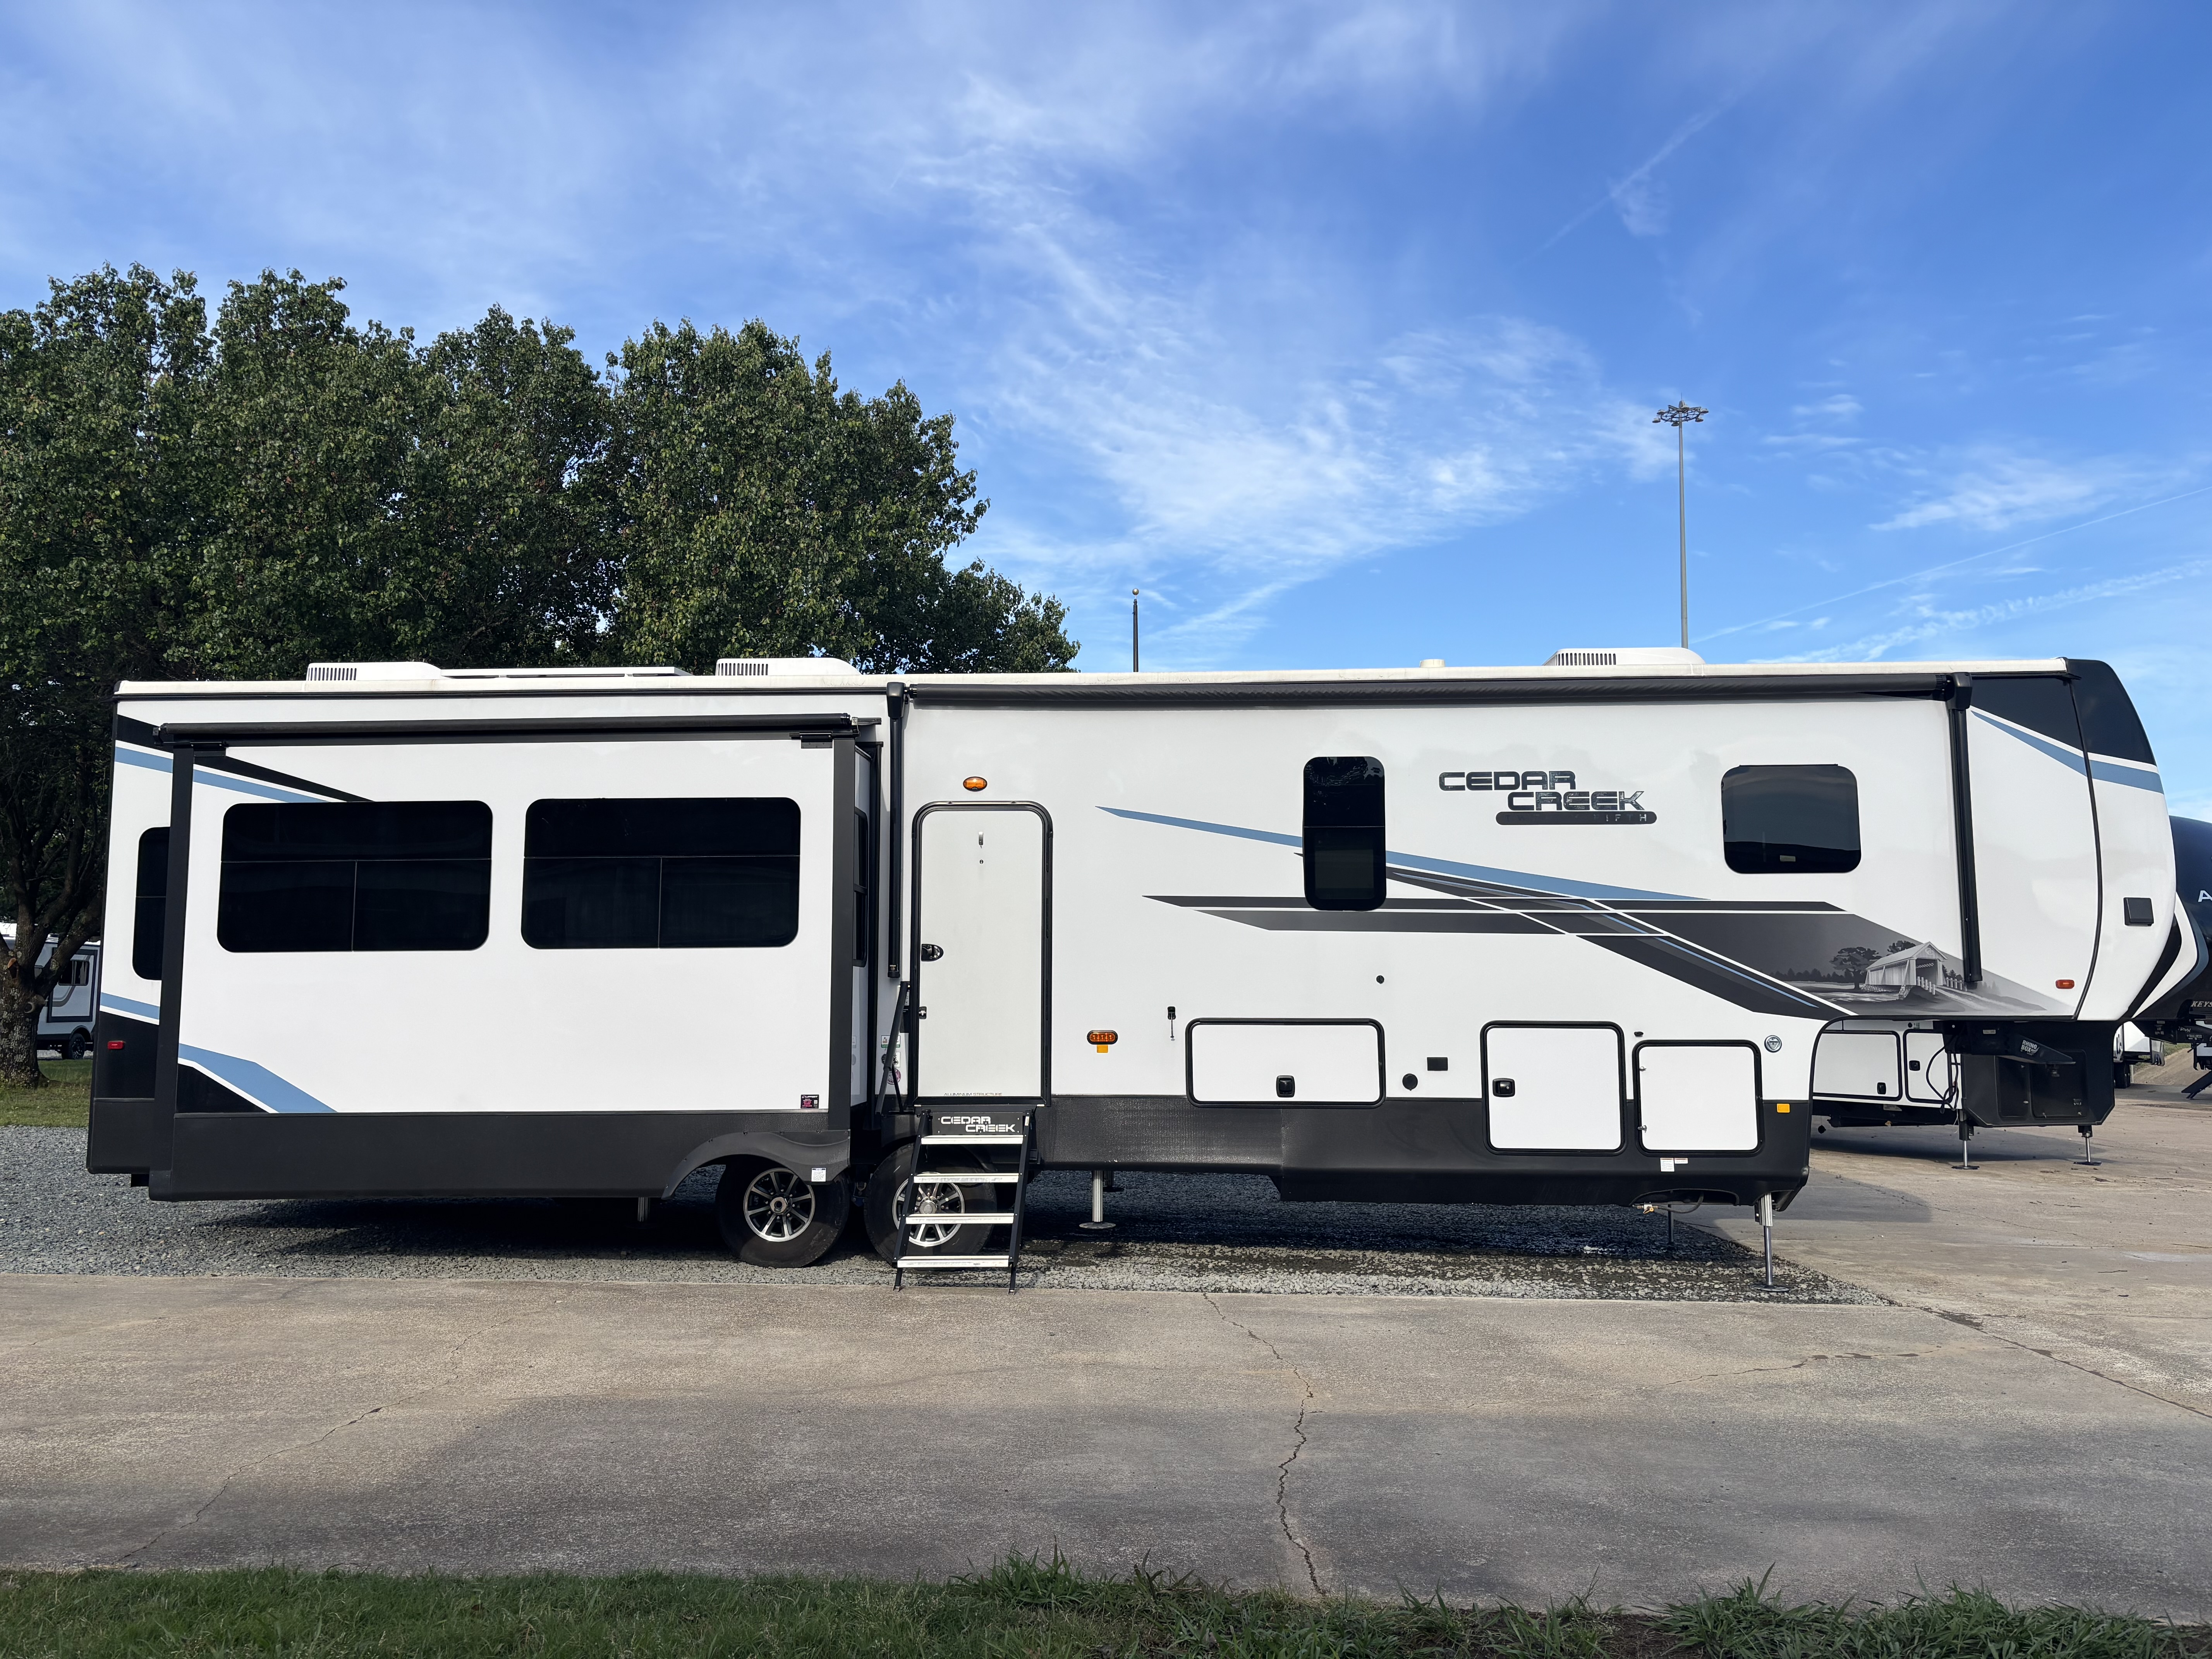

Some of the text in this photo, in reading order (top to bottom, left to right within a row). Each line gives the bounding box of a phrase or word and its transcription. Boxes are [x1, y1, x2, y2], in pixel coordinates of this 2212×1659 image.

[1439, 771, 1576, 791] CEDAR
[1508, 791, 1644, 811] CREEK
[2021, 1044, 2032, 1053] BOX
[2022, 1040, 2037, 1049] RHINO
[941, 1116, 991, 1125] CEDAR
[965, 1124, 1015, 1132] CREEK
